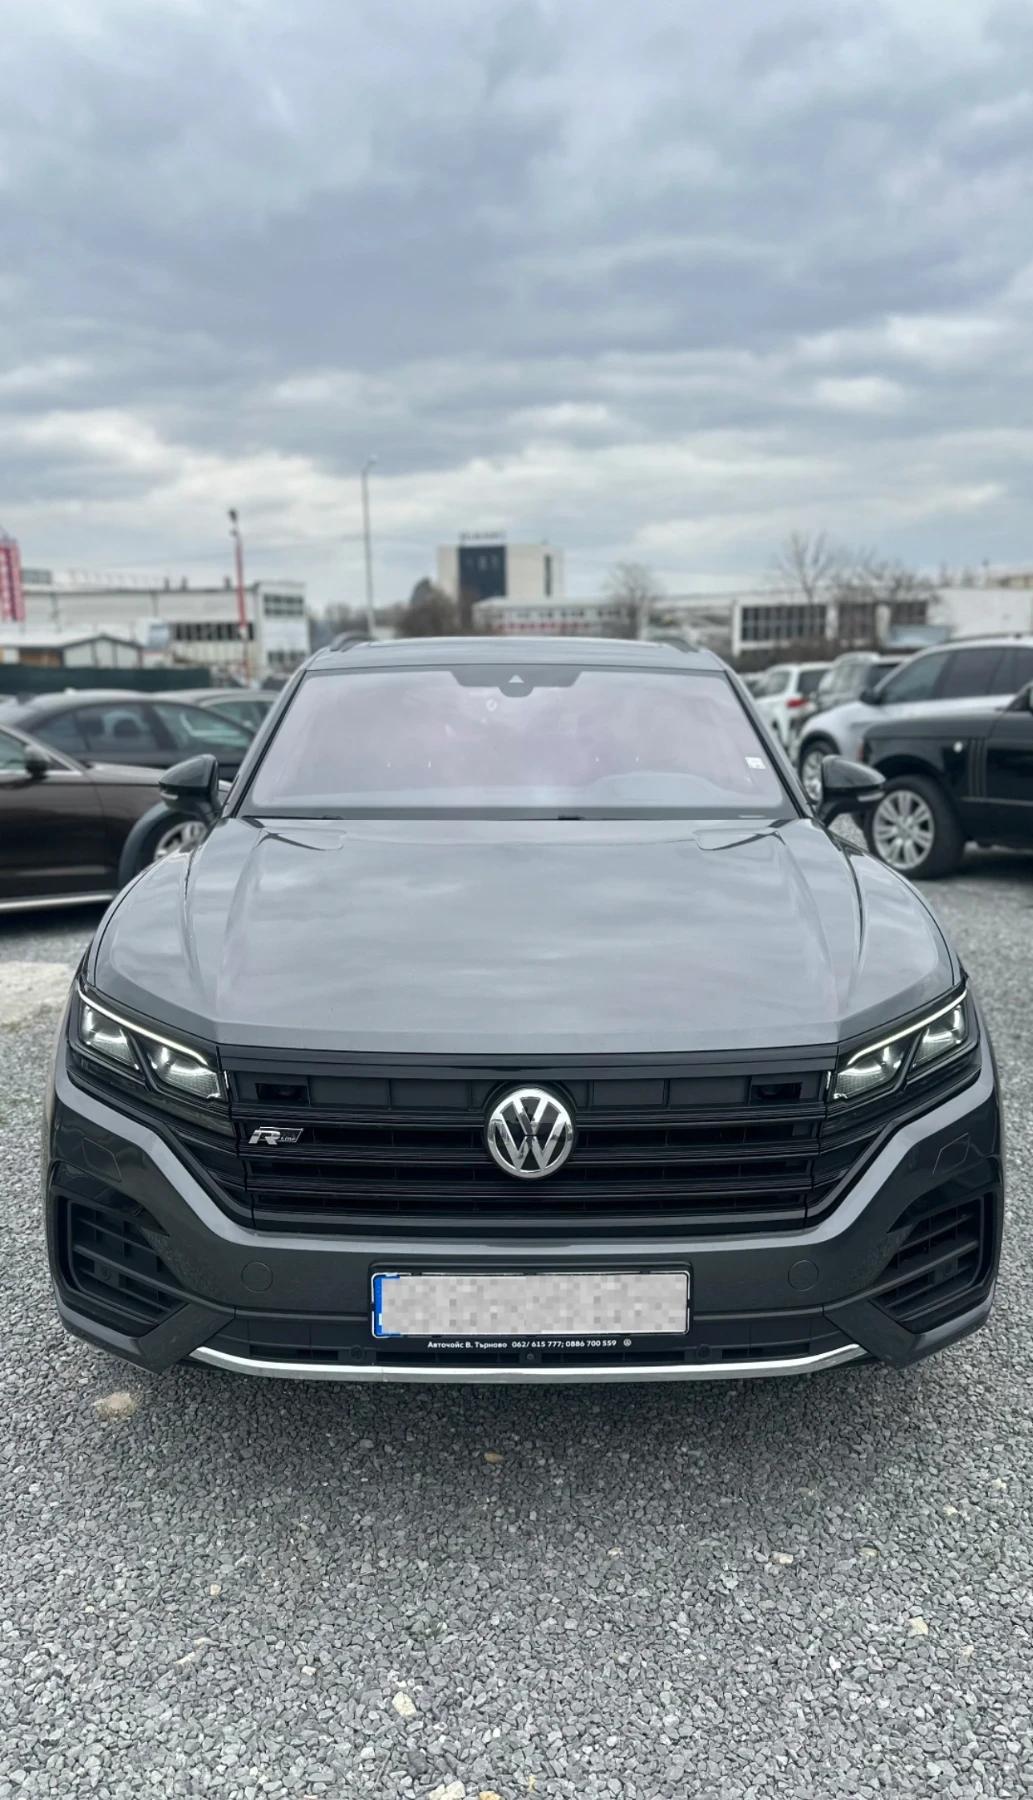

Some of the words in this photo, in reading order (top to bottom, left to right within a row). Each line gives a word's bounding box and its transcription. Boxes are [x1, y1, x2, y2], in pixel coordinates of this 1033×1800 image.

[489, 1089, 572, 1176] VW
[427, 1341, 464, 1349] Авточойс
[474, 1341, 508, 1350] Търново
[511, 1341, 530, 1349] 062/
[547, 1340, 564, 1348] 777;
[565, 1340, 585, 1348] 0886
[586, 1340, 601, 1348] 700
[602, 1339, 617, 1347] 559
